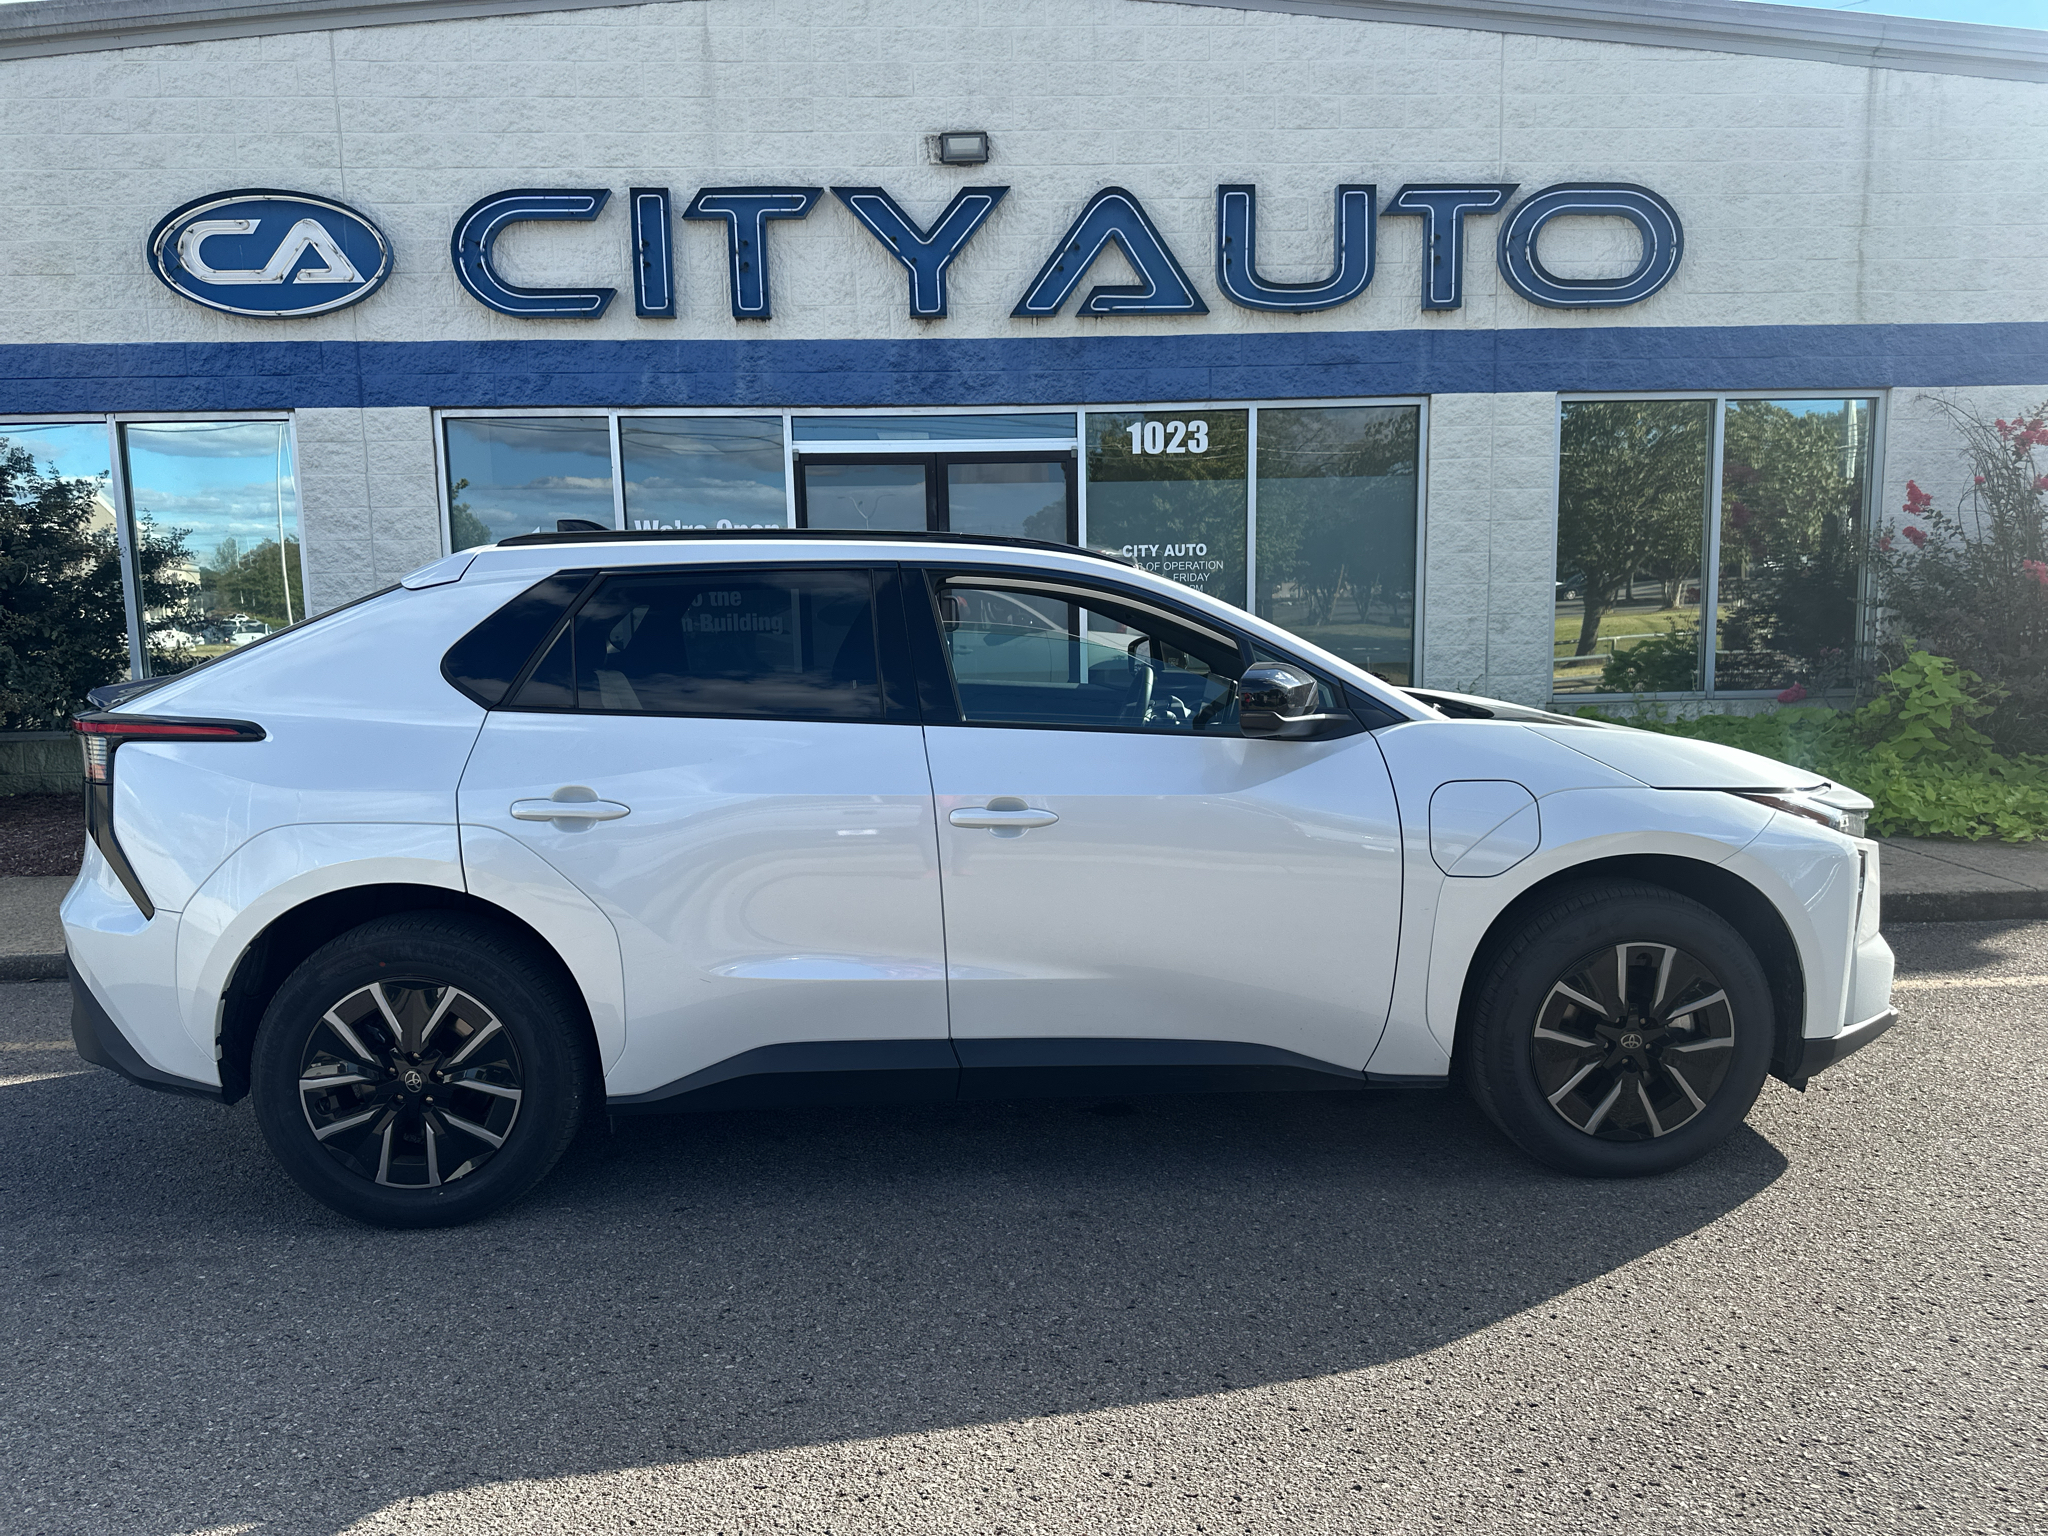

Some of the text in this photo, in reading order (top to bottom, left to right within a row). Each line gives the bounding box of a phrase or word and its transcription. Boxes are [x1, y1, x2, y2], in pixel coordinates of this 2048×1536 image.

[177, 217, 367, 285] CA
[451, 182, 1685, 320] CITY AUTO
[1126, 420, 1209, 455] 1023
[1122, 543, 1208, 558] CITY AUTO
[1145, 561, 1161, 572] OF
[1163, 560, 1224, 571] OPERATION
[1173, 572, 1211, 582] FRIDAY
[681, 613, 783, 635] n-Building
